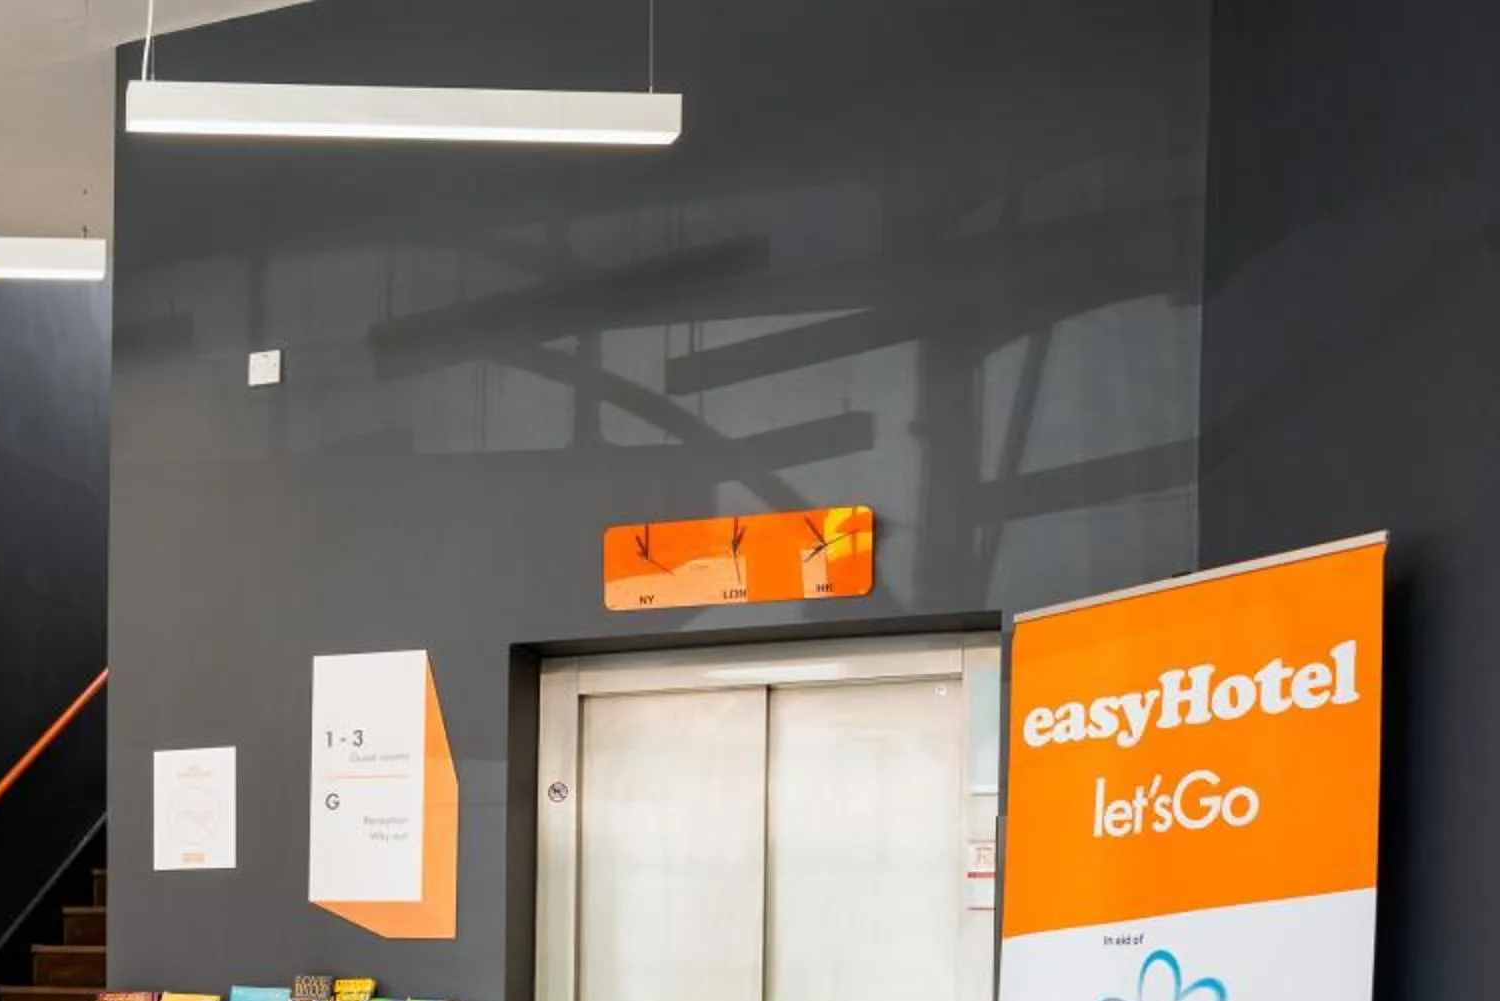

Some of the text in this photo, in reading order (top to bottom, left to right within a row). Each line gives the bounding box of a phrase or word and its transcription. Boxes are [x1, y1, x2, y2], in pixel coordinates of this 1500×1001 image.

[1021, 639, 1360, 749] easyHotel
[325, 731, 333, 748] 1
[352, 729, 363, 748] 3
[325, 793, 340, 811] G
[1103, 934, 1144, 945] In aid of
